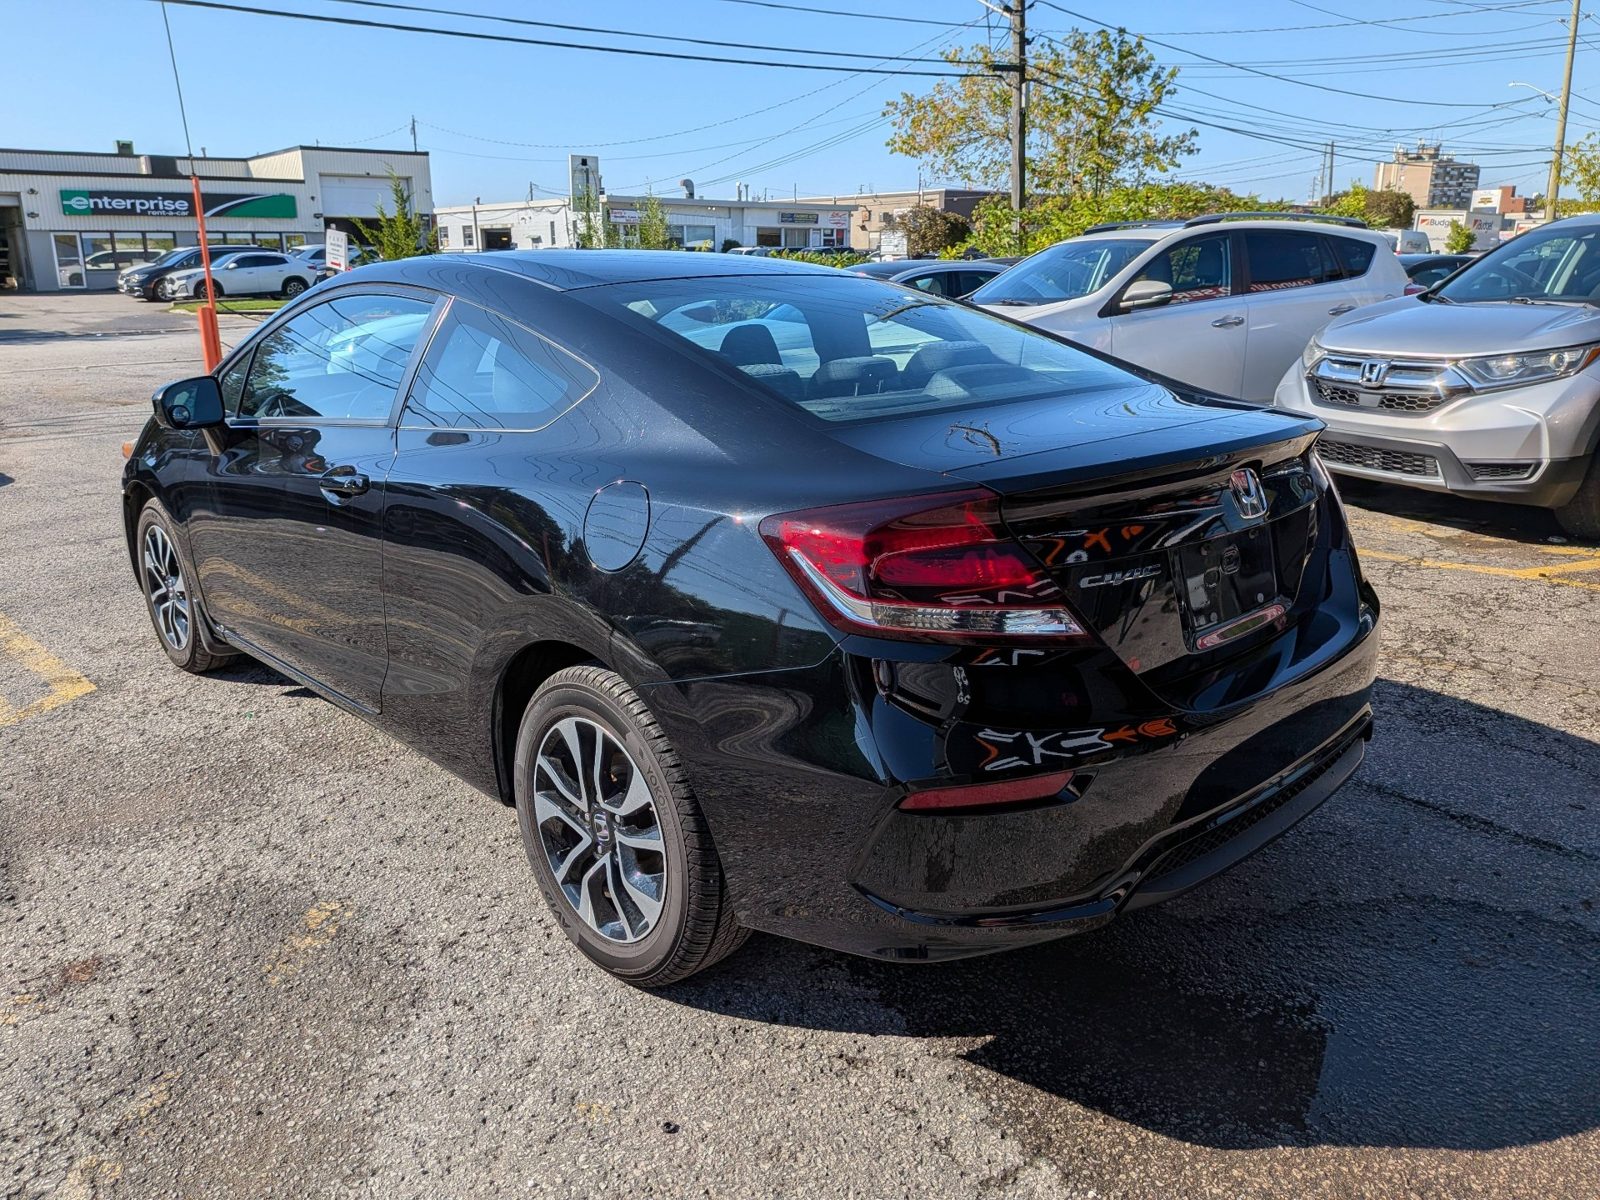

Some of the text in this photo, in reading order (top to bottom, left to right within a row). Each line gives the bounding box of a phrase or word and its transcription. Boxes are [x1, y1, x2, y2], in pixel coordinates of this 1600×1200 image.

[70, 196, 189, 213] enterprise
[1430, 218, 1452, 228] Budg
[1080, 563, 1161, 588] CIVIC
